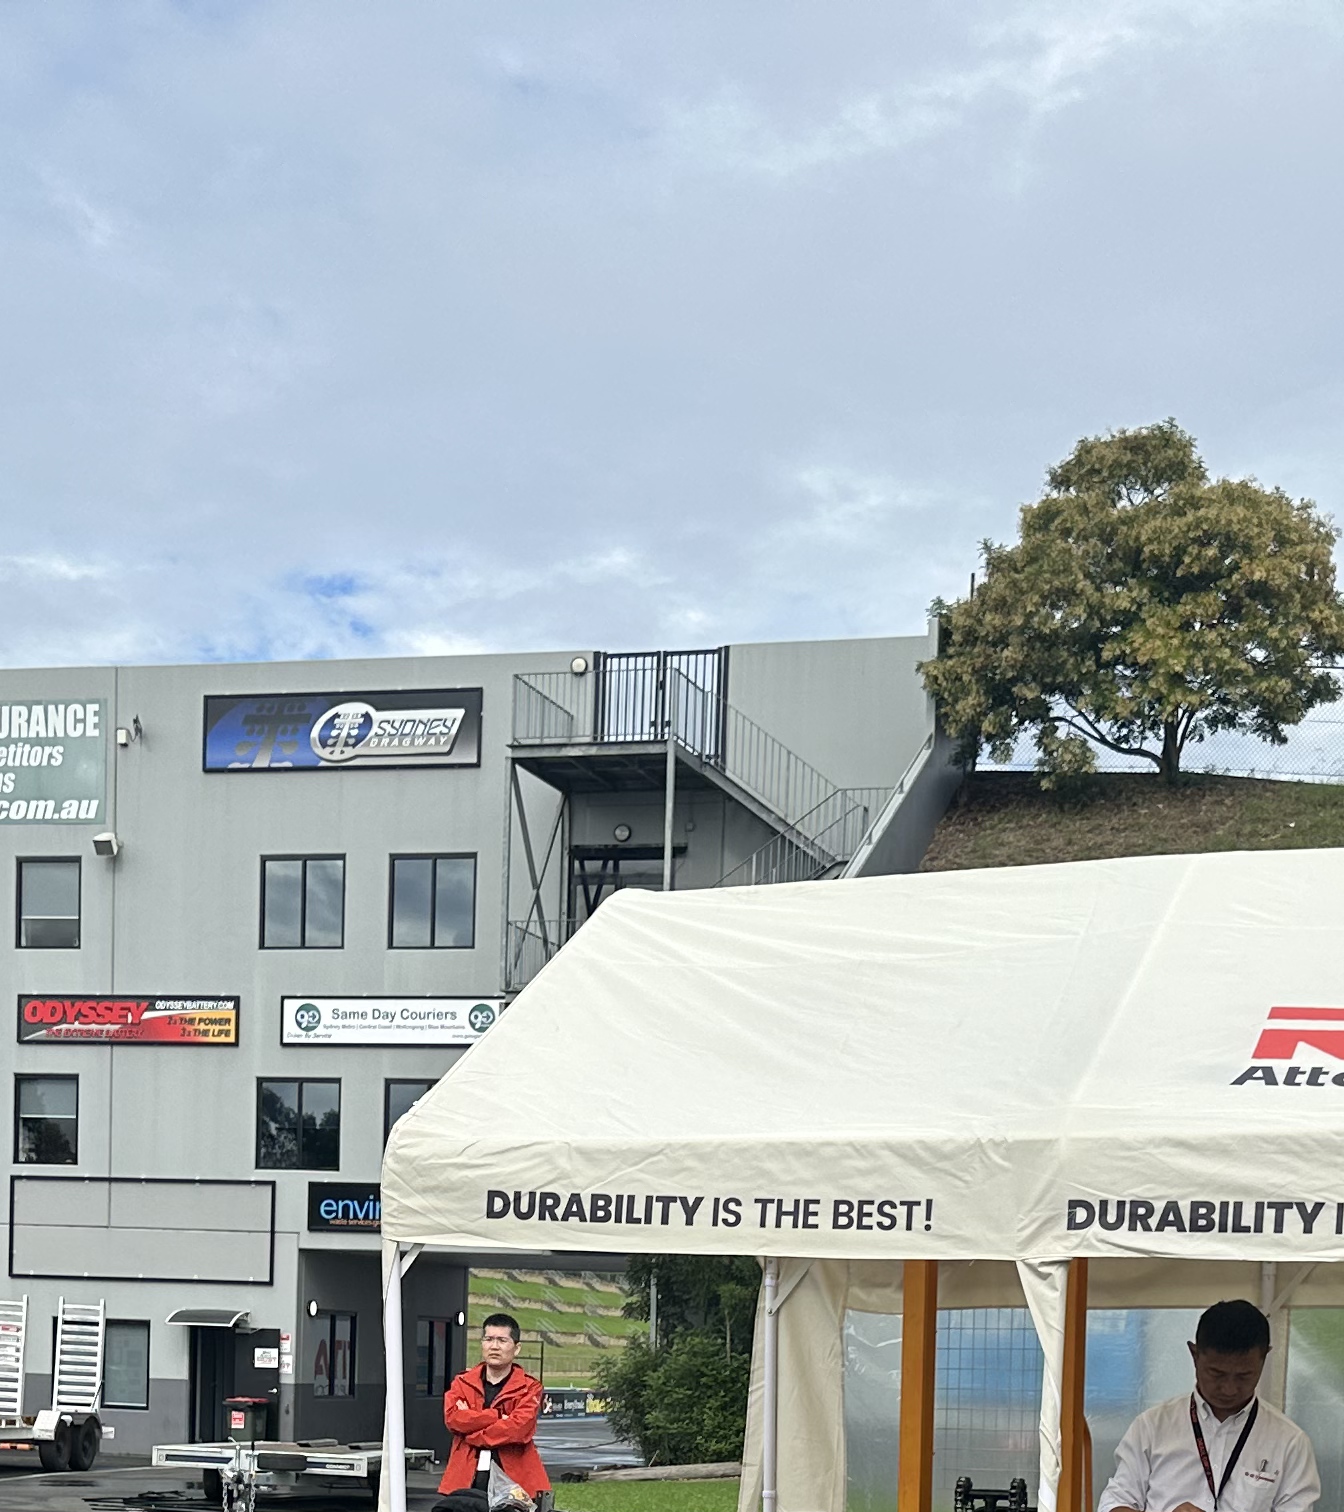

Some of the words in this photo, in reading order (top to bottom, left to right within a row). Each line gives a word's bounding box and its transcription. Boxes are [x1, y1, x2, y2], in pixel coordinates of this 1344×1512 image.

[374, 717, 457, 737] SYDNEY
[369, 736, 448, 747] DRAGWAY
[23, 1000, 149, 1024] ODYSSEY
[331, 1008, 368, 1020] Same
[372, 1008, 396, 1023] Day
[400, 1008, 458, 1020] Couriers
[198, 1017, 231, 1026] POWER
[212, 1028, 231, 1037] LIFE
[485, 1189, 706, 1228] DURABILITY
[712, 1198, 741, 1228] IS
[754, 1198, 819, 1230] THE
[833, 1198, 933, 1232] BEST!
[1067, 1199, 1325, 1235] DURABILITY
